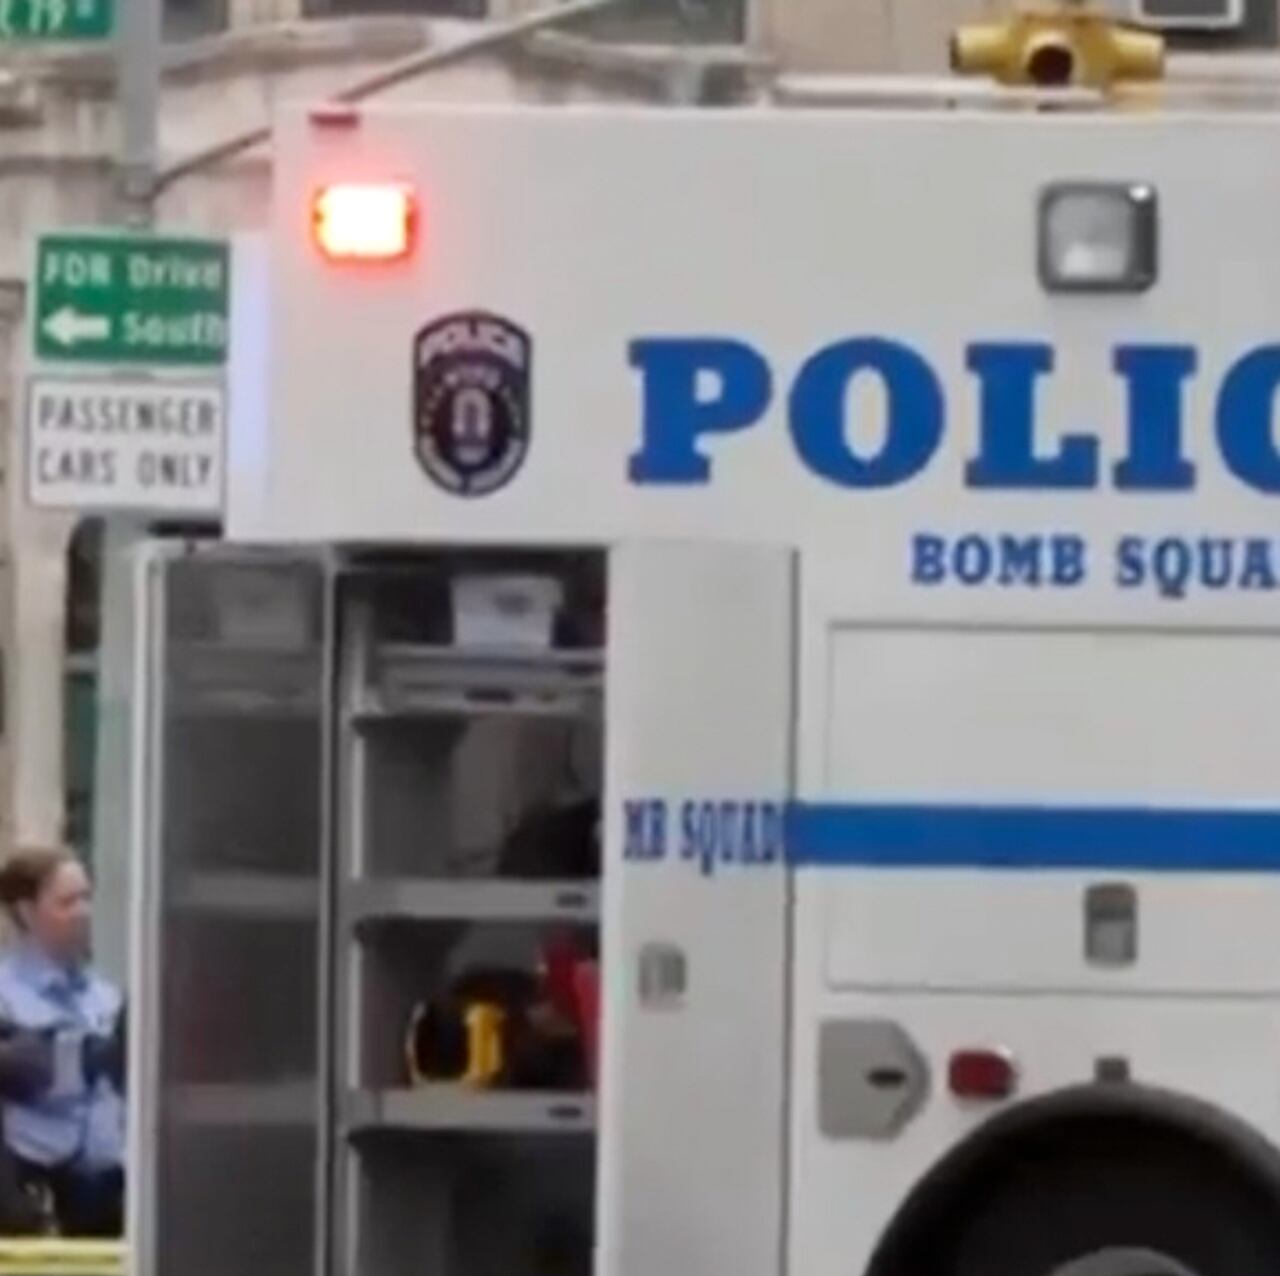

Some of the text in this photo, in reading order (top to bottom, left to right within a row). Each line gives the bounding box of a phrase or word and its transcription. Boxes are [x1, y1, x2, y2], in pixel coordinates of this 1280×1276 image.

[43, 252, 223, 290] FDR Drive
[122, 310, 228, 346] South
[39, 395, 216, 437] PASSENGER
[39, 448, 212, 487] CARS ONLY
[911, 532, 1280, 600] BOMB SQUA
